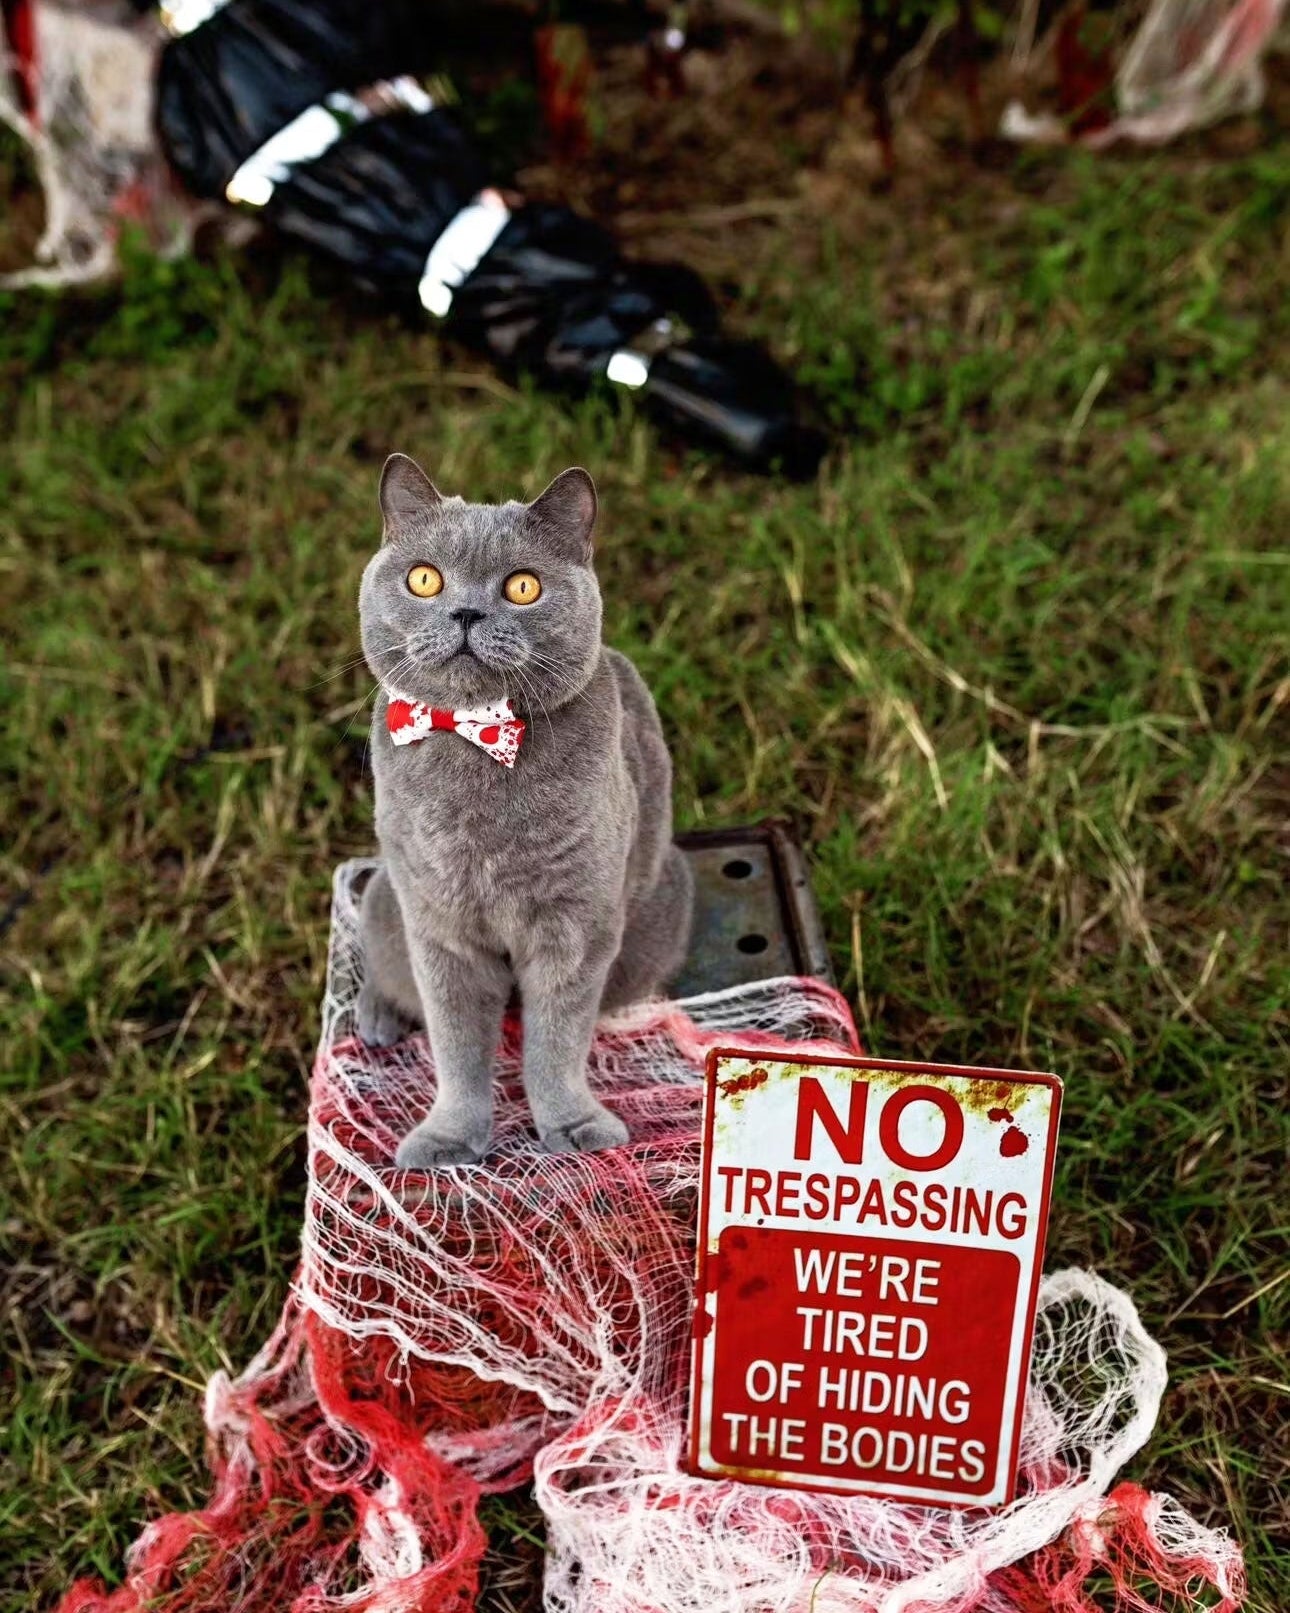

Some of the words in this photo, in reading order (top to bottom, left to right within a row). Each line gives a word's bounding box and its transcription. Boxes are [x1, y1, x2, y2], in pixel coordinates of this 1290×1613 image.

[793, 1076, 964, 1172] NO
[717, 1166, 1027, 1240] TRESPASSING
[793, 1248, 942, 1306] WE'RE
[796, 1307, 929, 1362] TIRED
[745, 1359, 805, 1404] OF
[818, 1365, 971, 1425] HIDING
[722, 1412, 806, 1461] THE
[820, 1422, 986, 1484] BODIES
